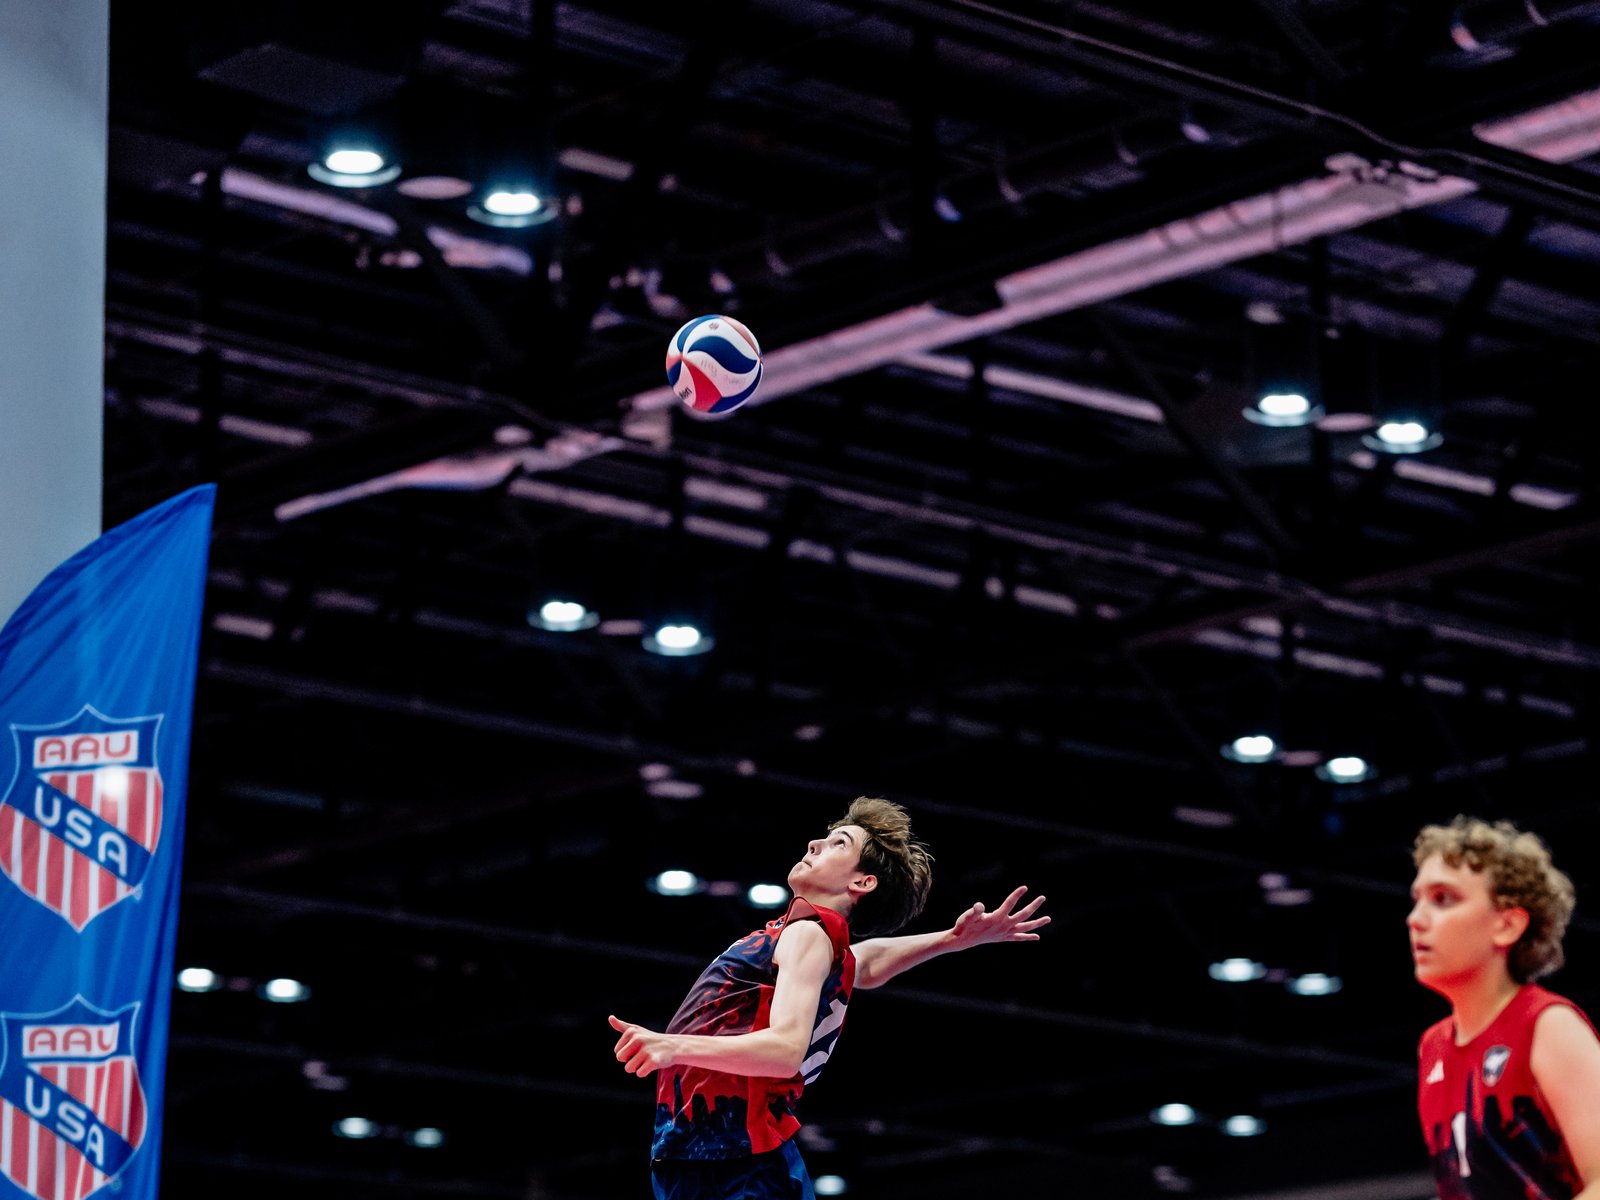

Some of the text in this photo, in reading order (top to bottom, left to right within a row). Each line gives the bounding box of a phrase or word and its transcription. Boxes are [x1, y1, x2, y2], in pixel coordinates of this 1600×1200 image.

[39, 734, 131, 763] AAU
[35, 785, 127, 876] USA
[28, 1025, 116, 1052] AAU
[25, 1076, 104, 1167] USA
